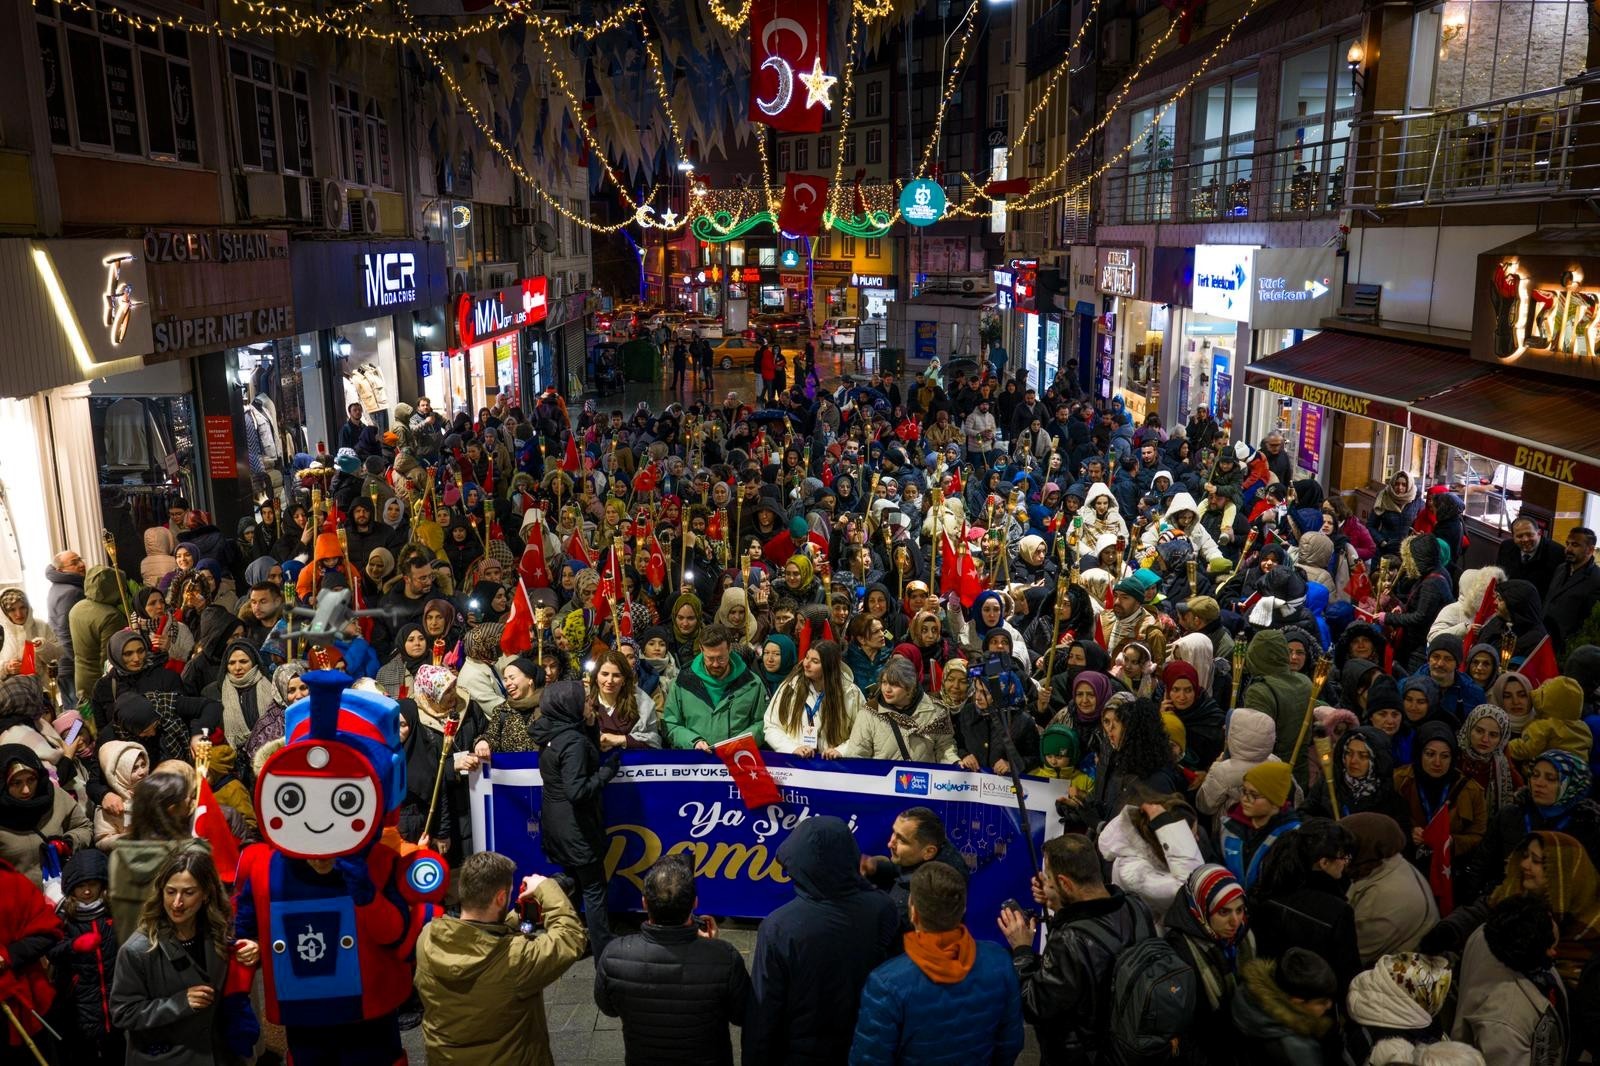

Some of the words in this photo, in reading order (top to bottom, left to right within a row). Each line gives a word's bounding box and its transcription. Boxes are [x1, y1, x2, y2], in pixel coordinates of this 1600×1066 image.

[143, 228, 214, 261] ÖZGEN
[365, 253, 415, 306] MCR
[1259, 289, 1307, 301] Telekom
[1303, 384, 1372, 415] RESTAURANT
[615, 768, 667, 778] OCAELi
[671, 768, 731, 778] BÜYÜKŞ
[679, 801, 746, 838] Ya
